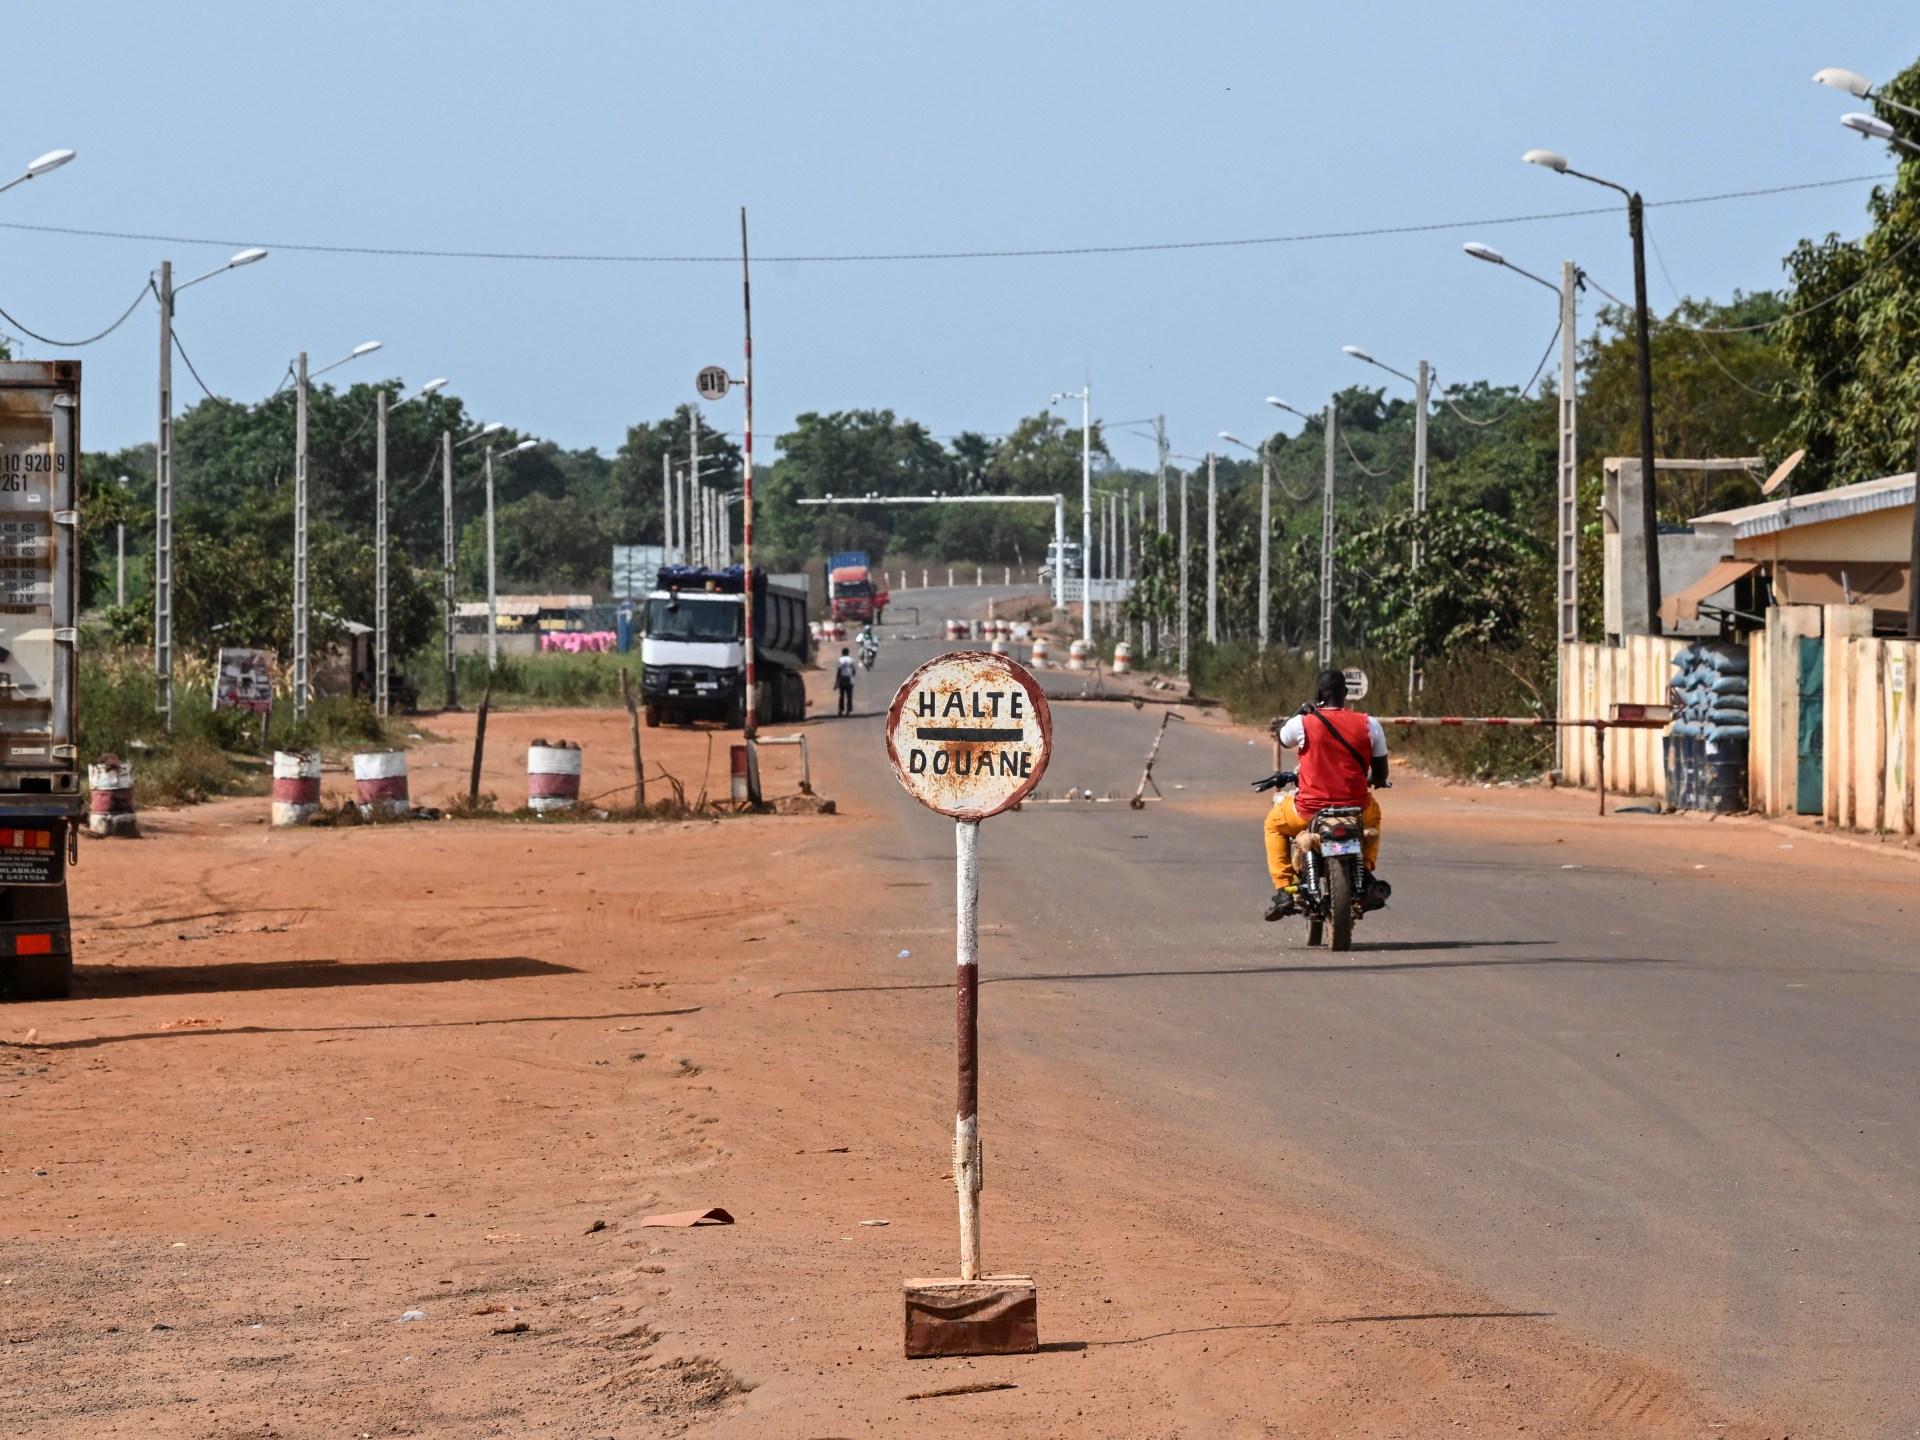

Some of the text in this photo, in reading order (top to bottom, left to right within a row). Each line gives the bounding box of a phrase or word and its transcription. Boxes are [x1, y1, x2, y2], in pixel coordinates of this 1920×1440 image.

[25, 454, 51, 472] 920
[57, 454, 65, 472] 9
[0, 473, 27, 492] 2G1
[21, 523, 35, 533] KGS
[21, 547, 35, 556] KGS
[21, 570, 35, 580] KGS
[919, 691, 1023, 719] HALTE
[909, 748, 1032, 779] DOUANE
